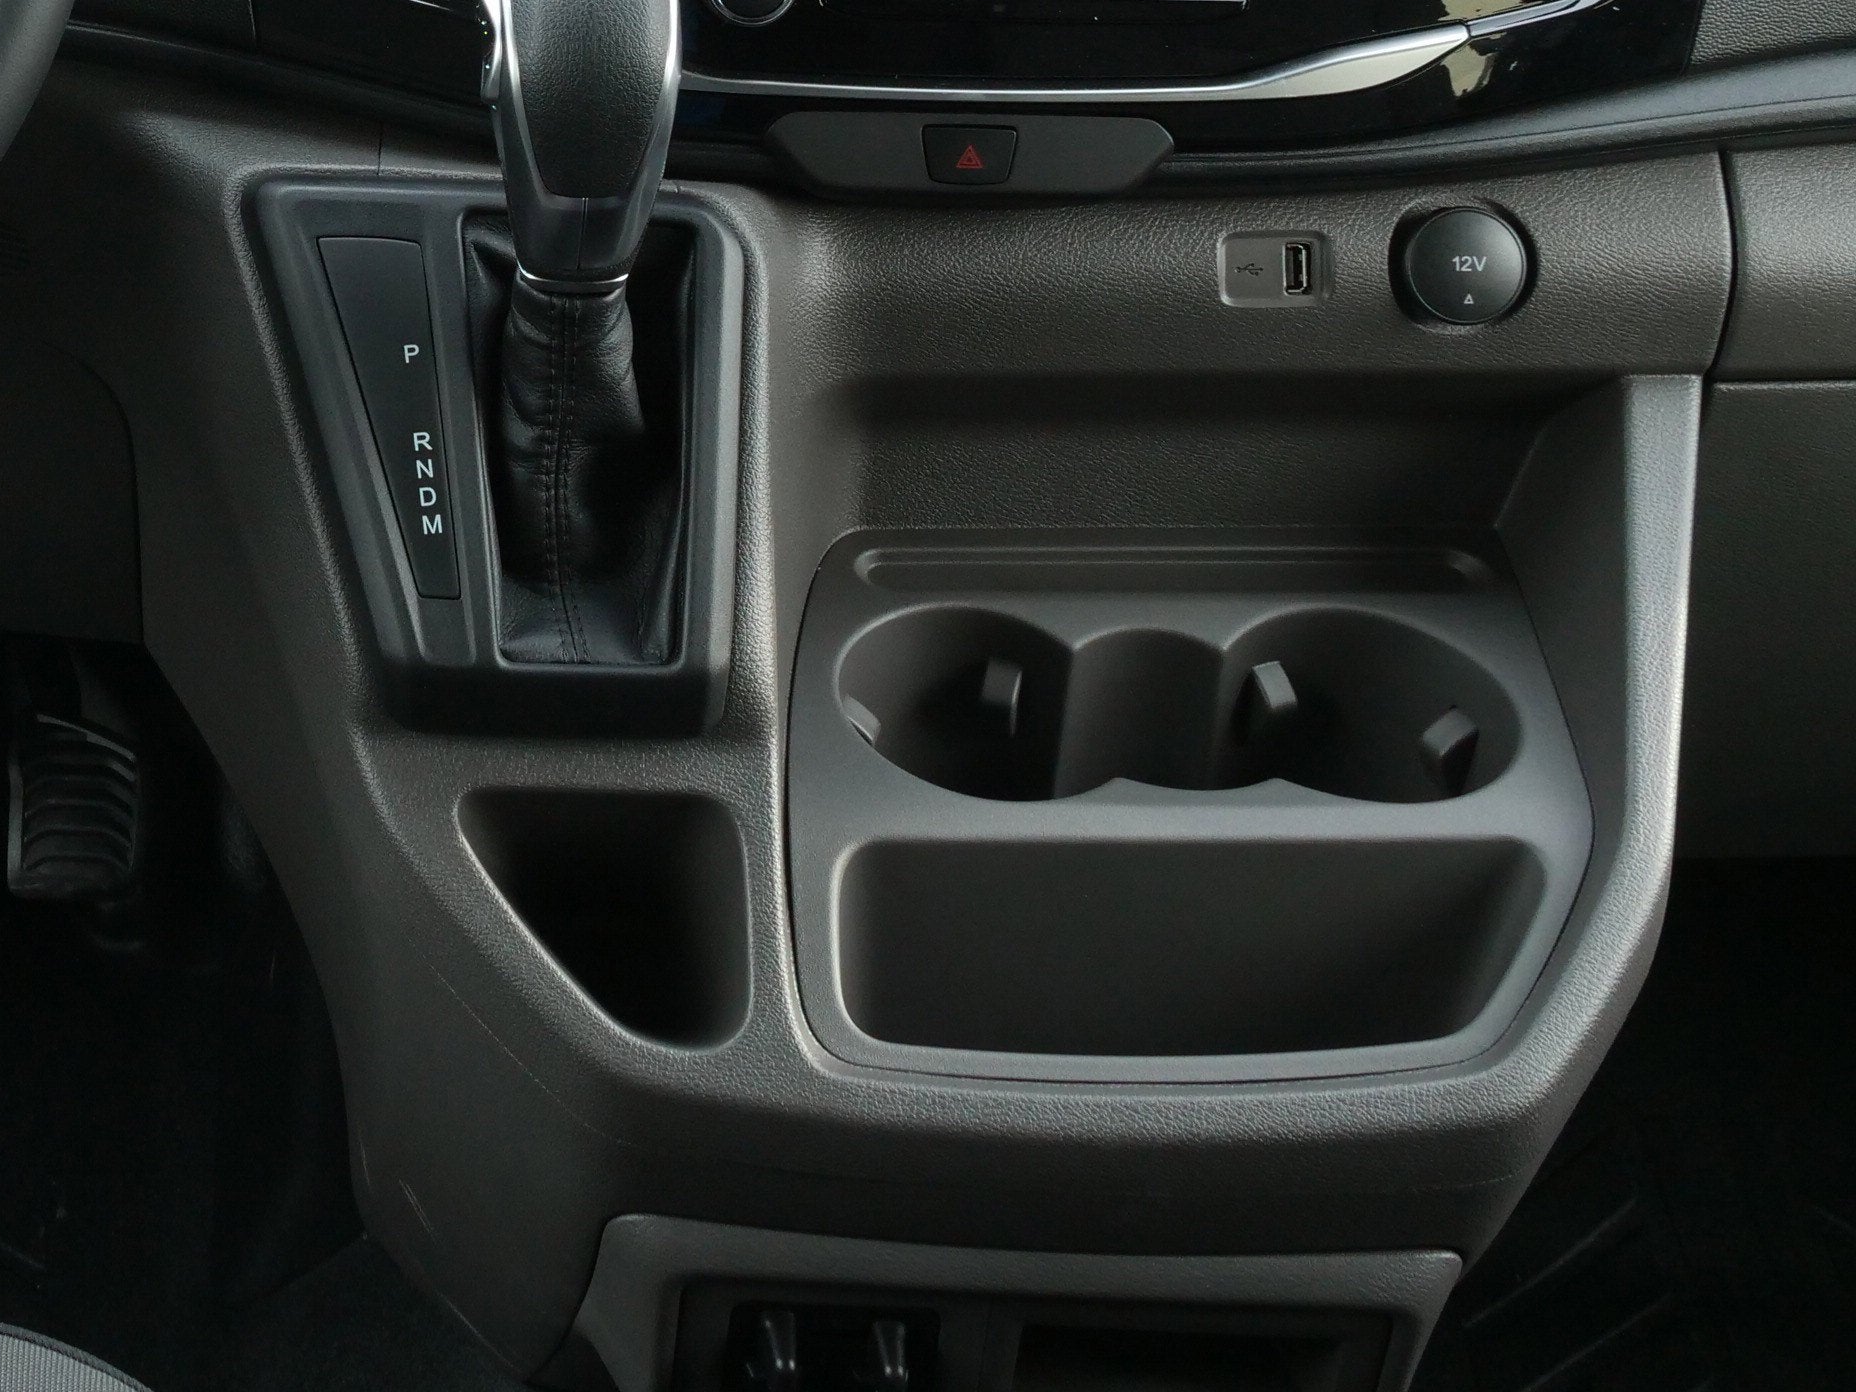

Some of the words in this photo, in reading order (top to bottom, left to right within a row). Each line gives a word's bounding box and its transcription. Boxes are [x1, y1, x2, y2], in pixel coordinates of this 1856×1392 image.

[1451, 255, 1488, 273] 12V
[403, 344, 420, 364] P
[413, 431, 433, 452] R
[415, 458, 434, 479] N
[419, 486, 437, 507] D
[422, 514, 443, 535] M
